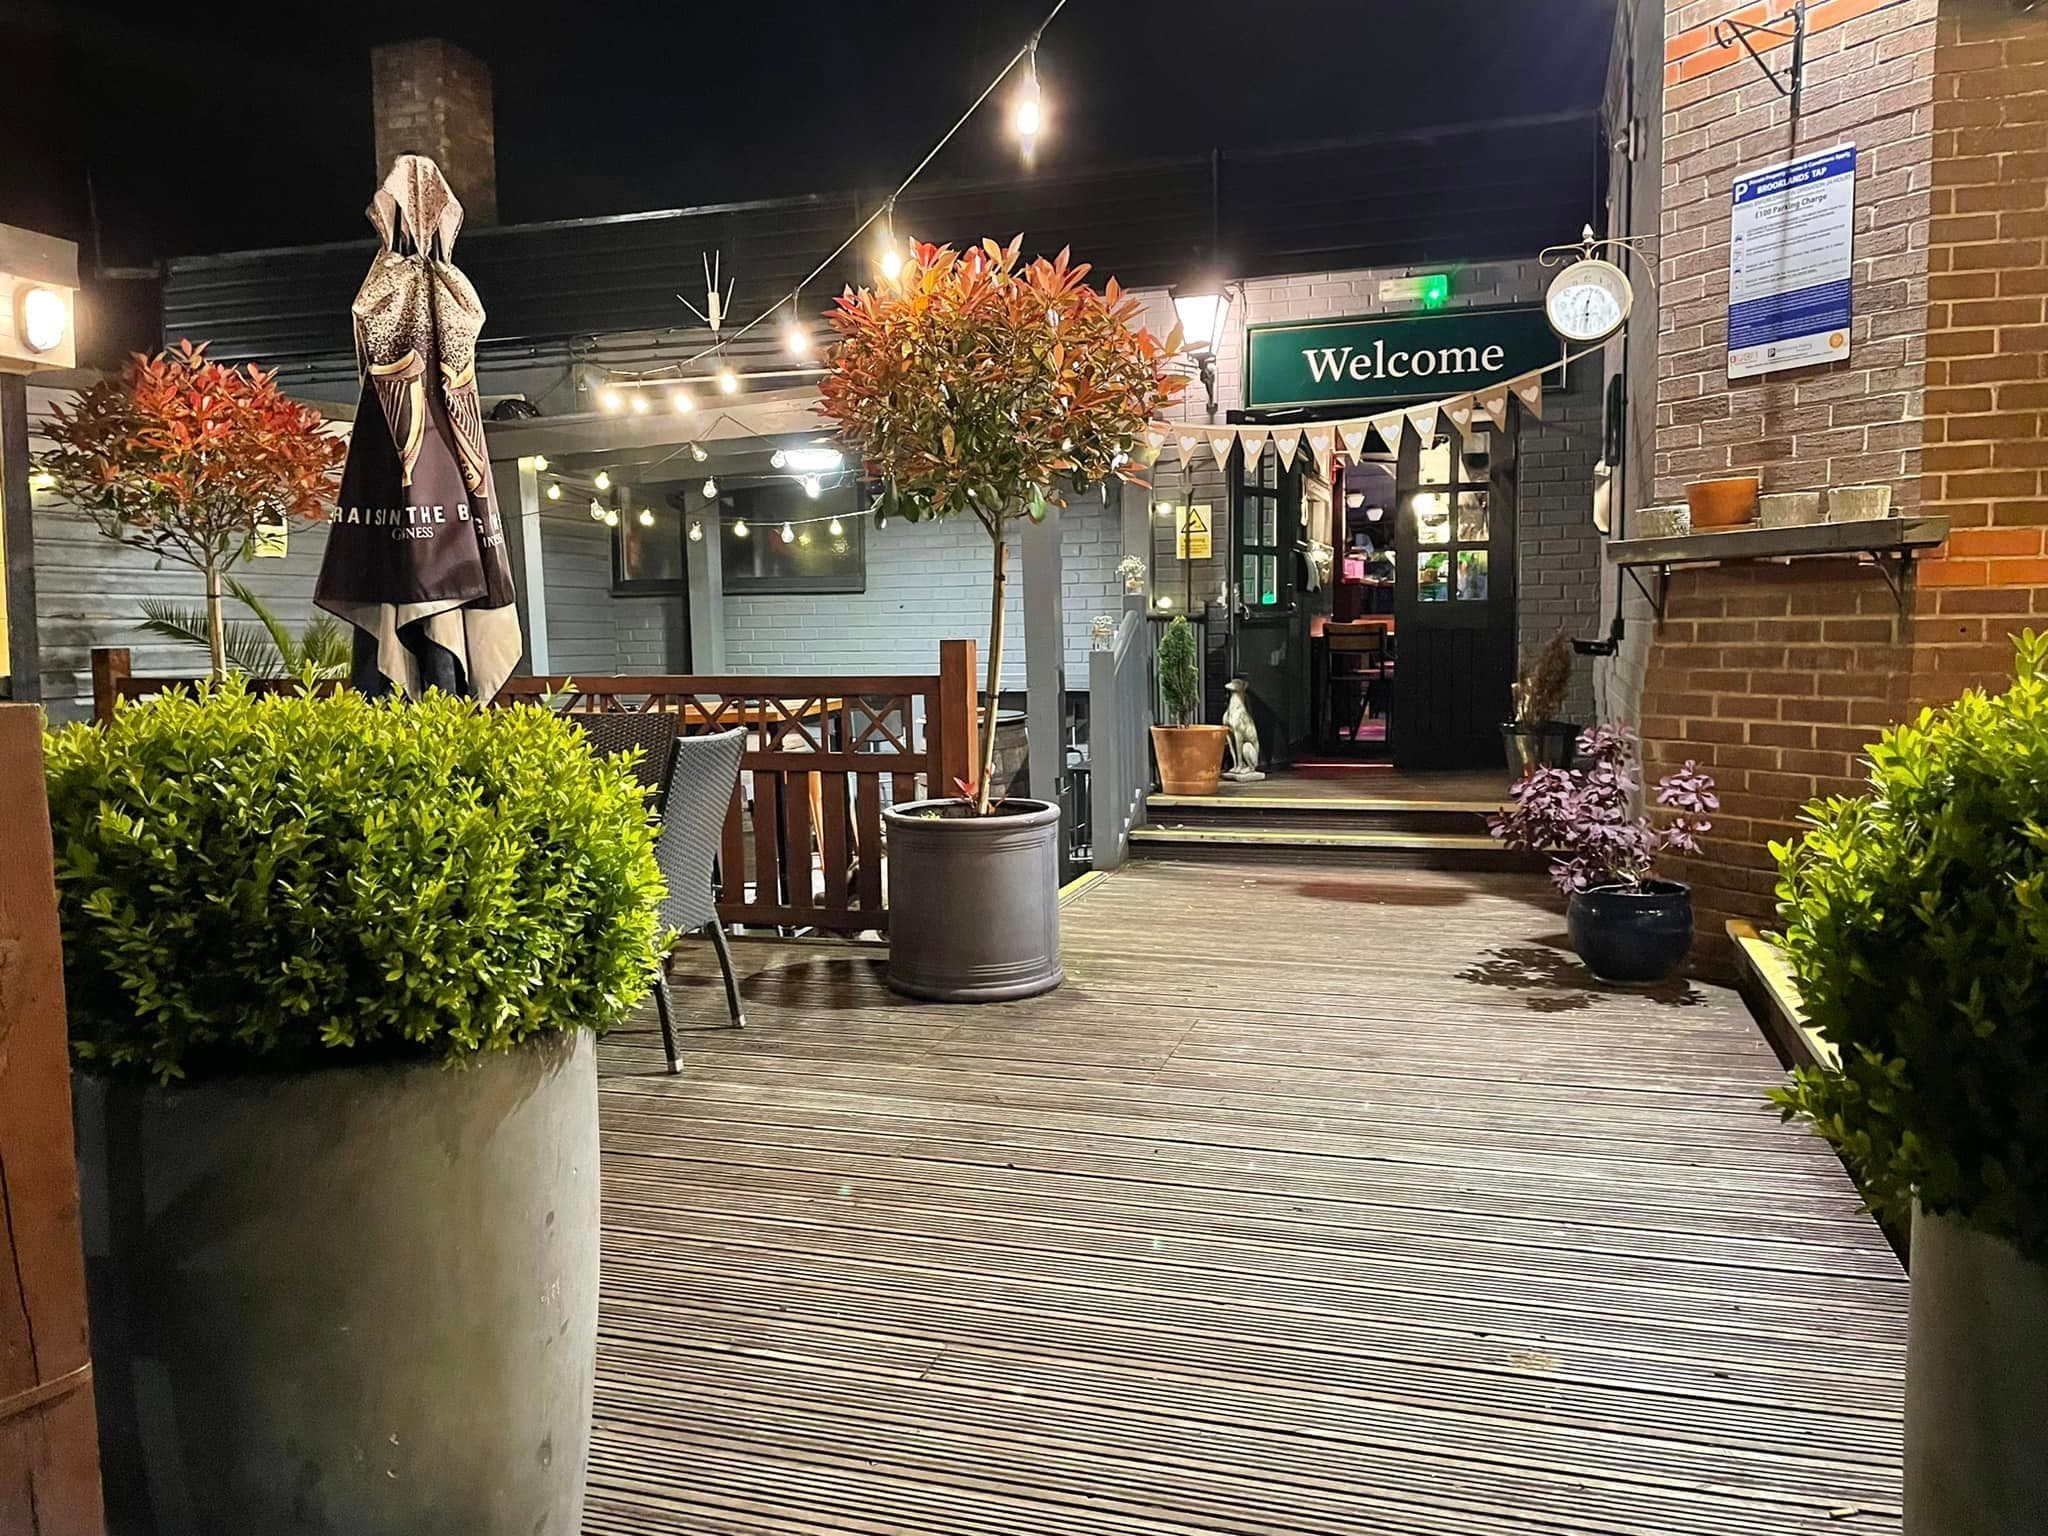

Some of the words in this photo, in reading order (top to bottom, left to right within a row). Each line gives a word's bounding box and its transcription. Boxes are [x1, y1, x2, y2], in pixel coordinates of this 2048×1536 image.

[1812, 166, 1828, 178] TAP
[1773, 201, 1800, 214] Parking
[1801, 193, 1828, 207] Charge
[1302, 339, 1505, 383] Welcome
[405, 505, 446, 524] THE
